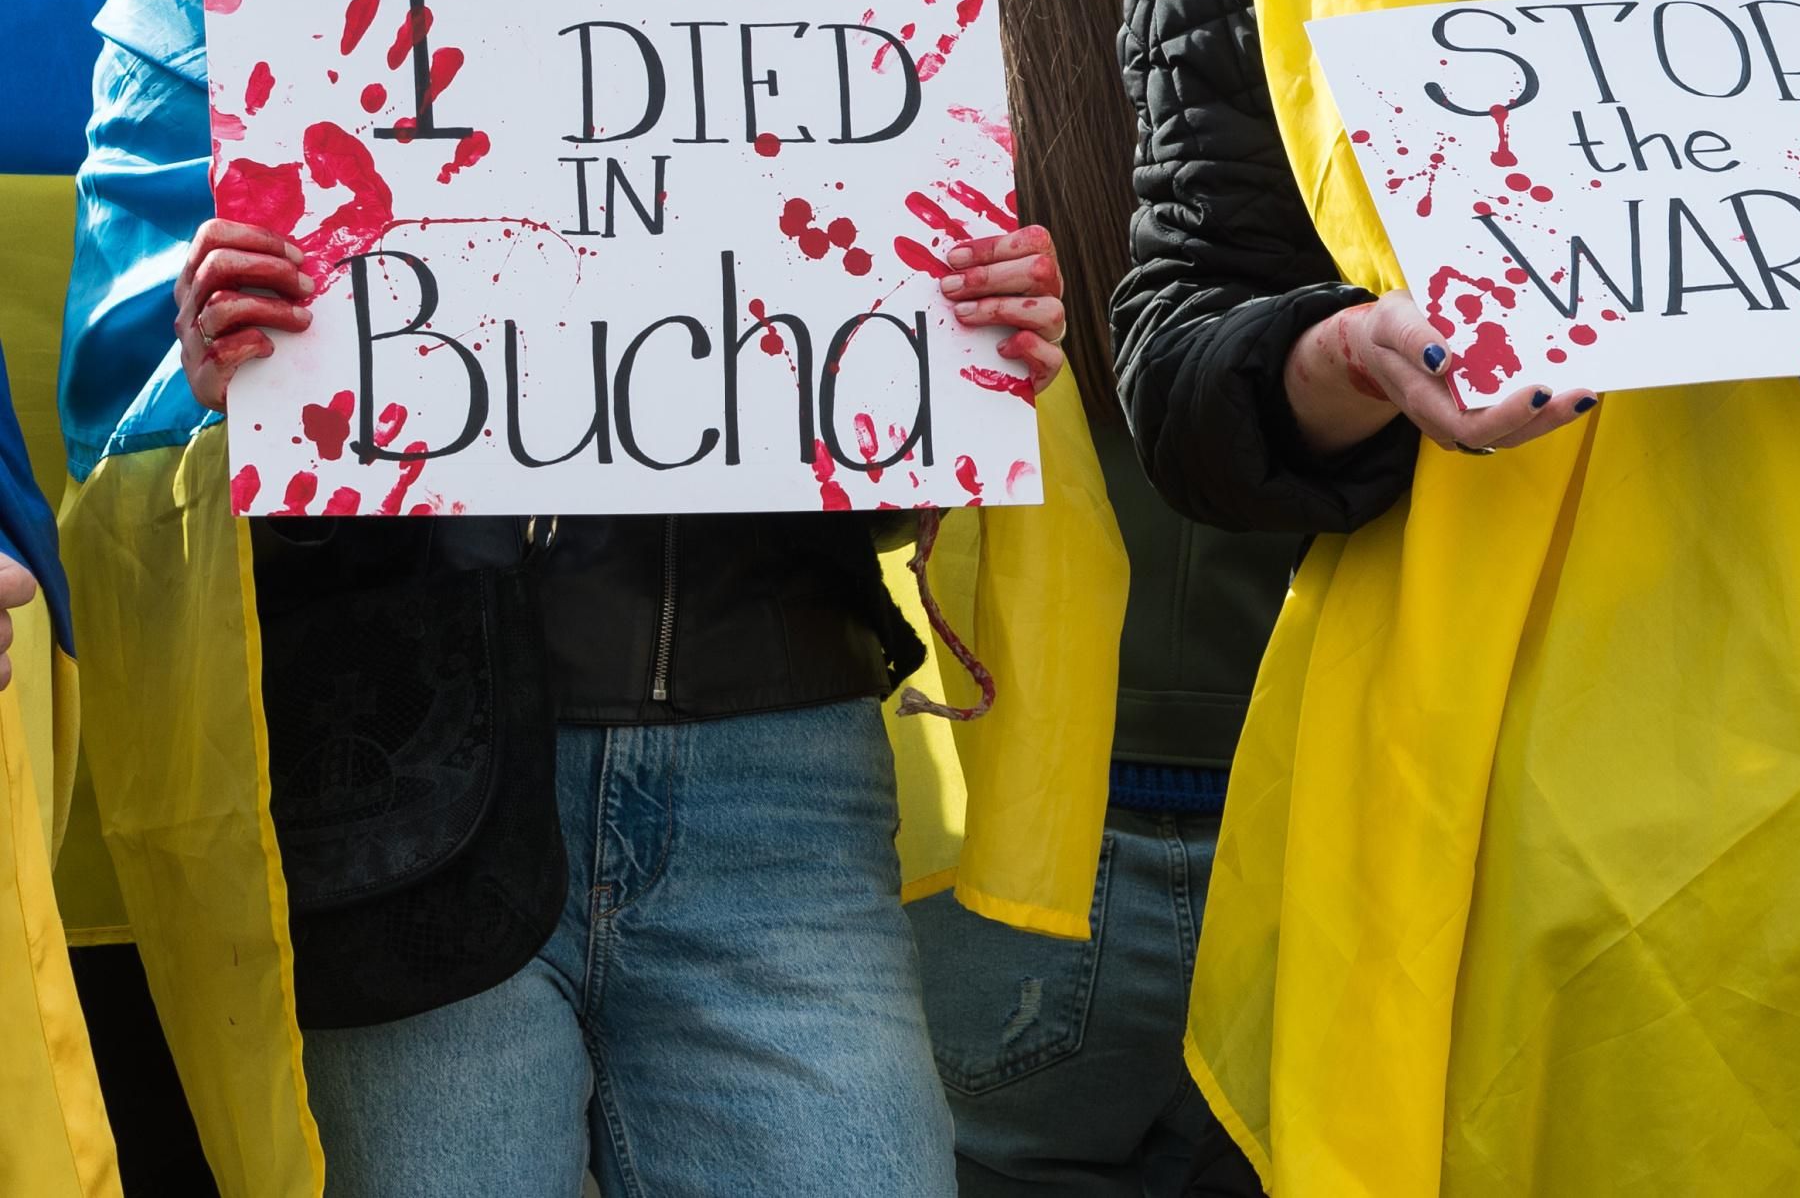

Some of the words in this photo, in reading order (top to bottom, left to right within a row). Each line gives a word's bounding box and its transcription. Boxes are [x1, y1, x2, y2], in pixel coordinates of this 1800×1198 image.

[558, 20, 922, 145] DIED
[1569, 106, 1740, 173] the
[558, 155, 671, 238] IN
[334, 249, 934, 472] Bucha
